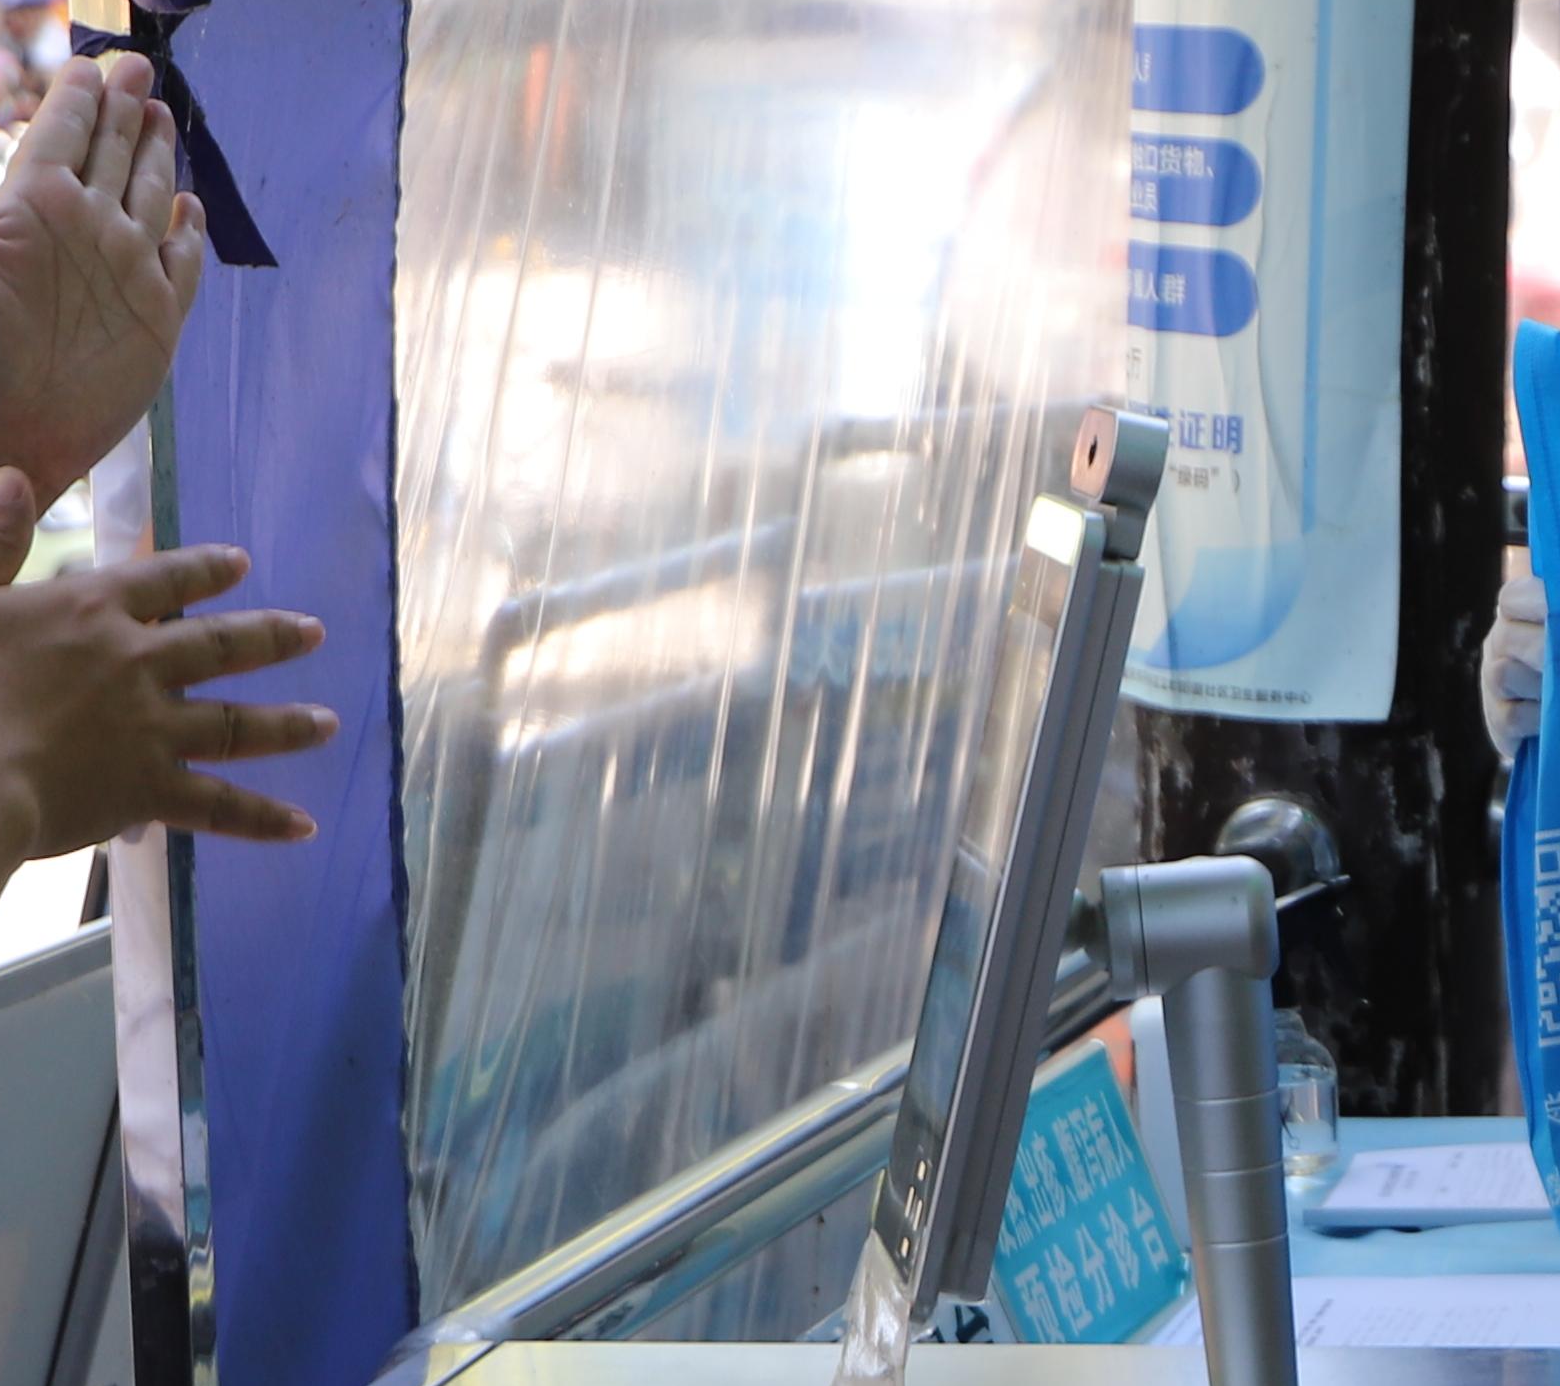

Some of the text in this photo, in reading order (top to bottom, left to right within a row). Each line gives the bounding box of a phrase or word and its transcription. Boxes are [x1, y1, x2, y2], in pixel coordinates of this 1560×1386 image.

[1013, 1186, 1170, 1344] 预检分诊台
